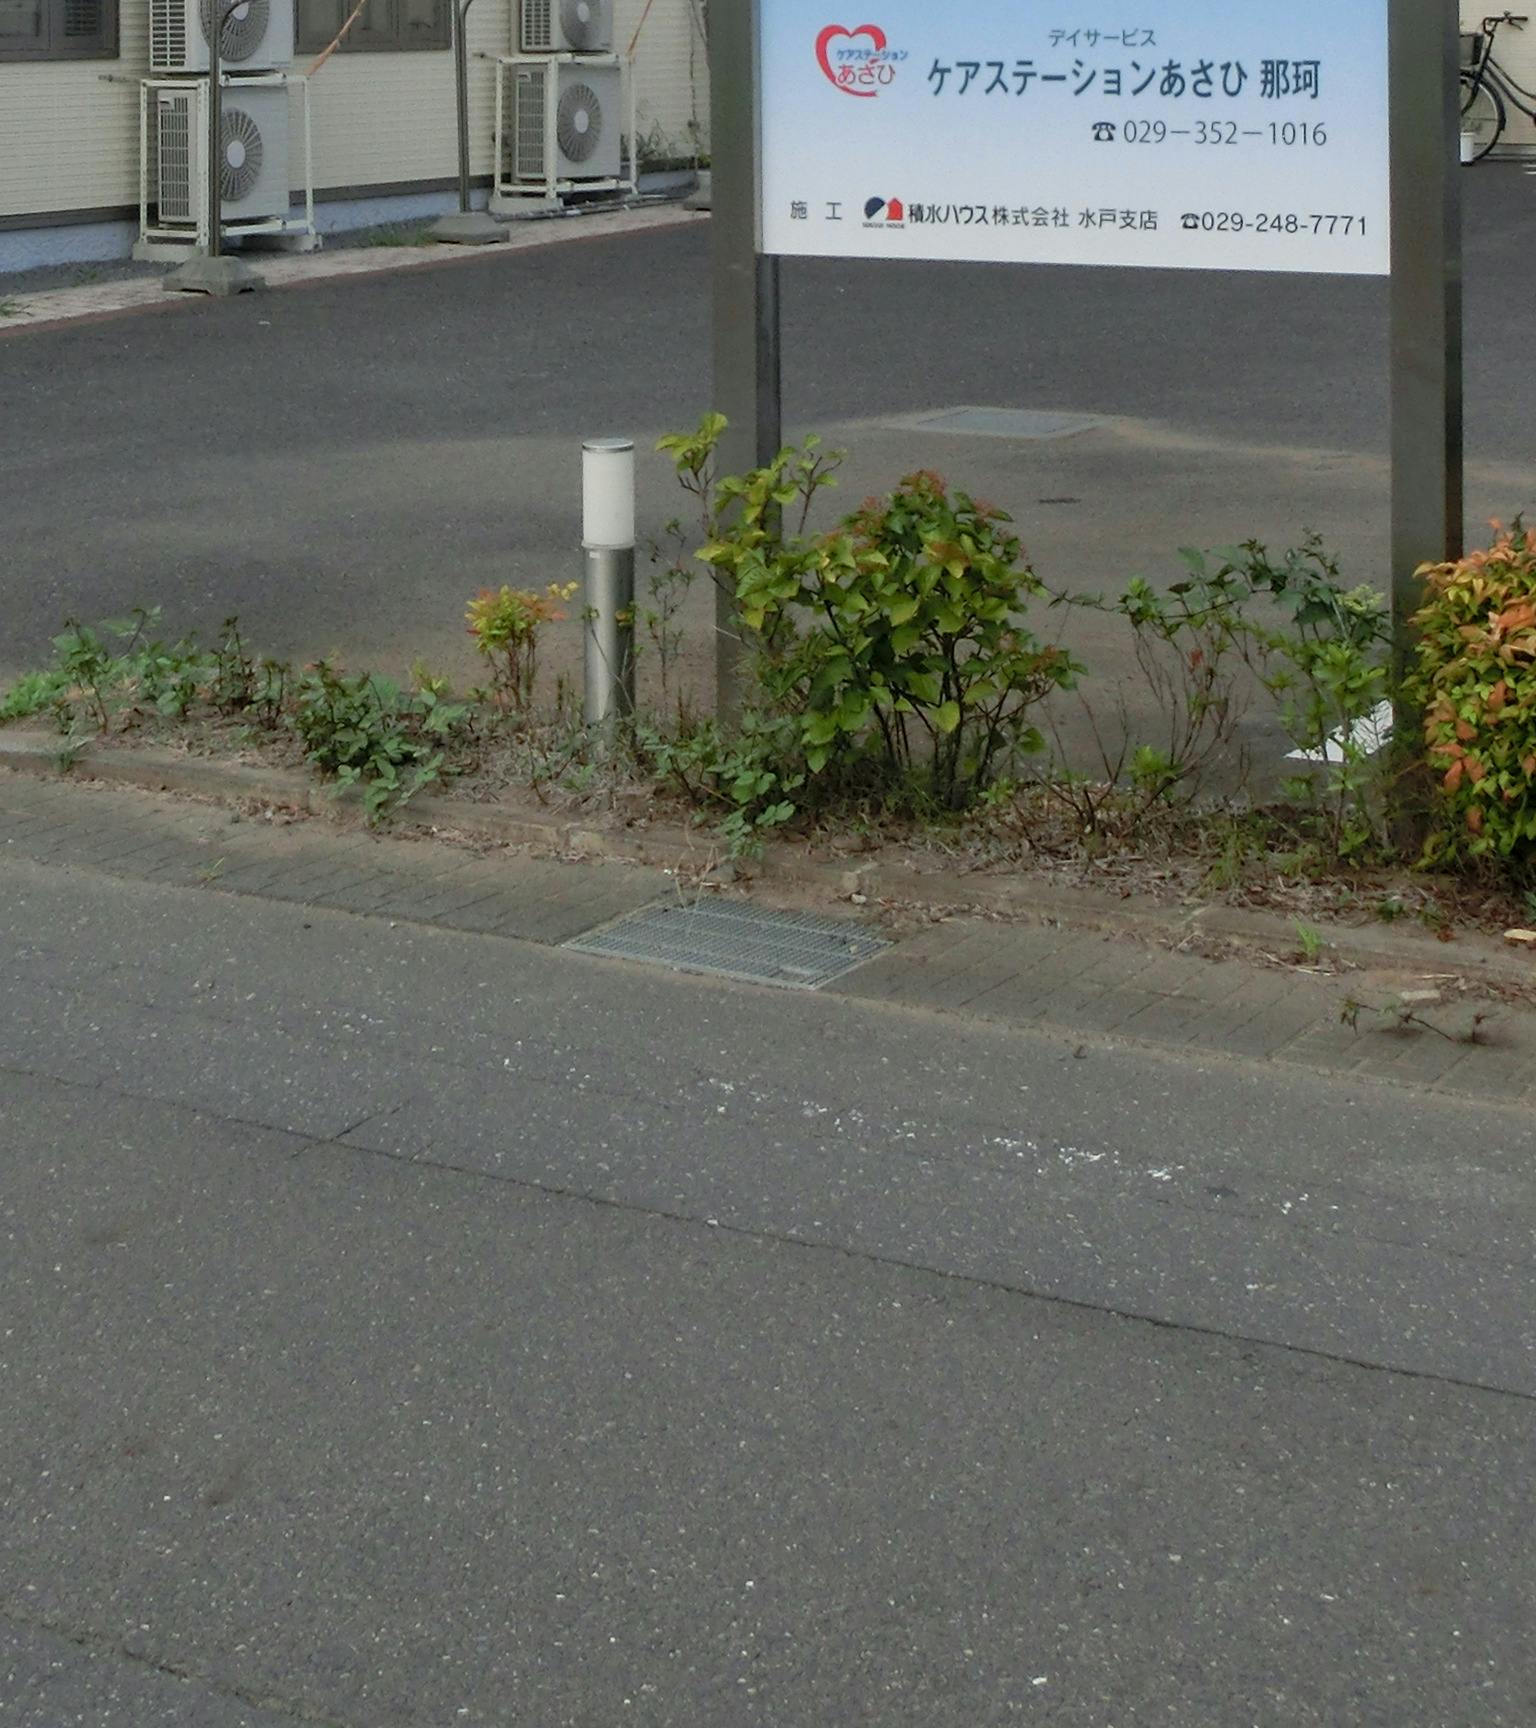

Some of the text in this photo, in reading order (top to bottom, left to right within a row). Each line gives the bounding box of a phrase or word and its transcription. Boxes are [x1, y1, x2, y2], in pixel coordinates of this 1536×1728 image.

[1048, 28, 1157, 48] デイサービス
[836, 48, 909, 62] ケアステーション
[837, 59, 896, 85] あさひ
[927, 58, 1321, 100] ケアステーションあさひ 那珂
[1078, 207, 1158, 231] 水戸支店
